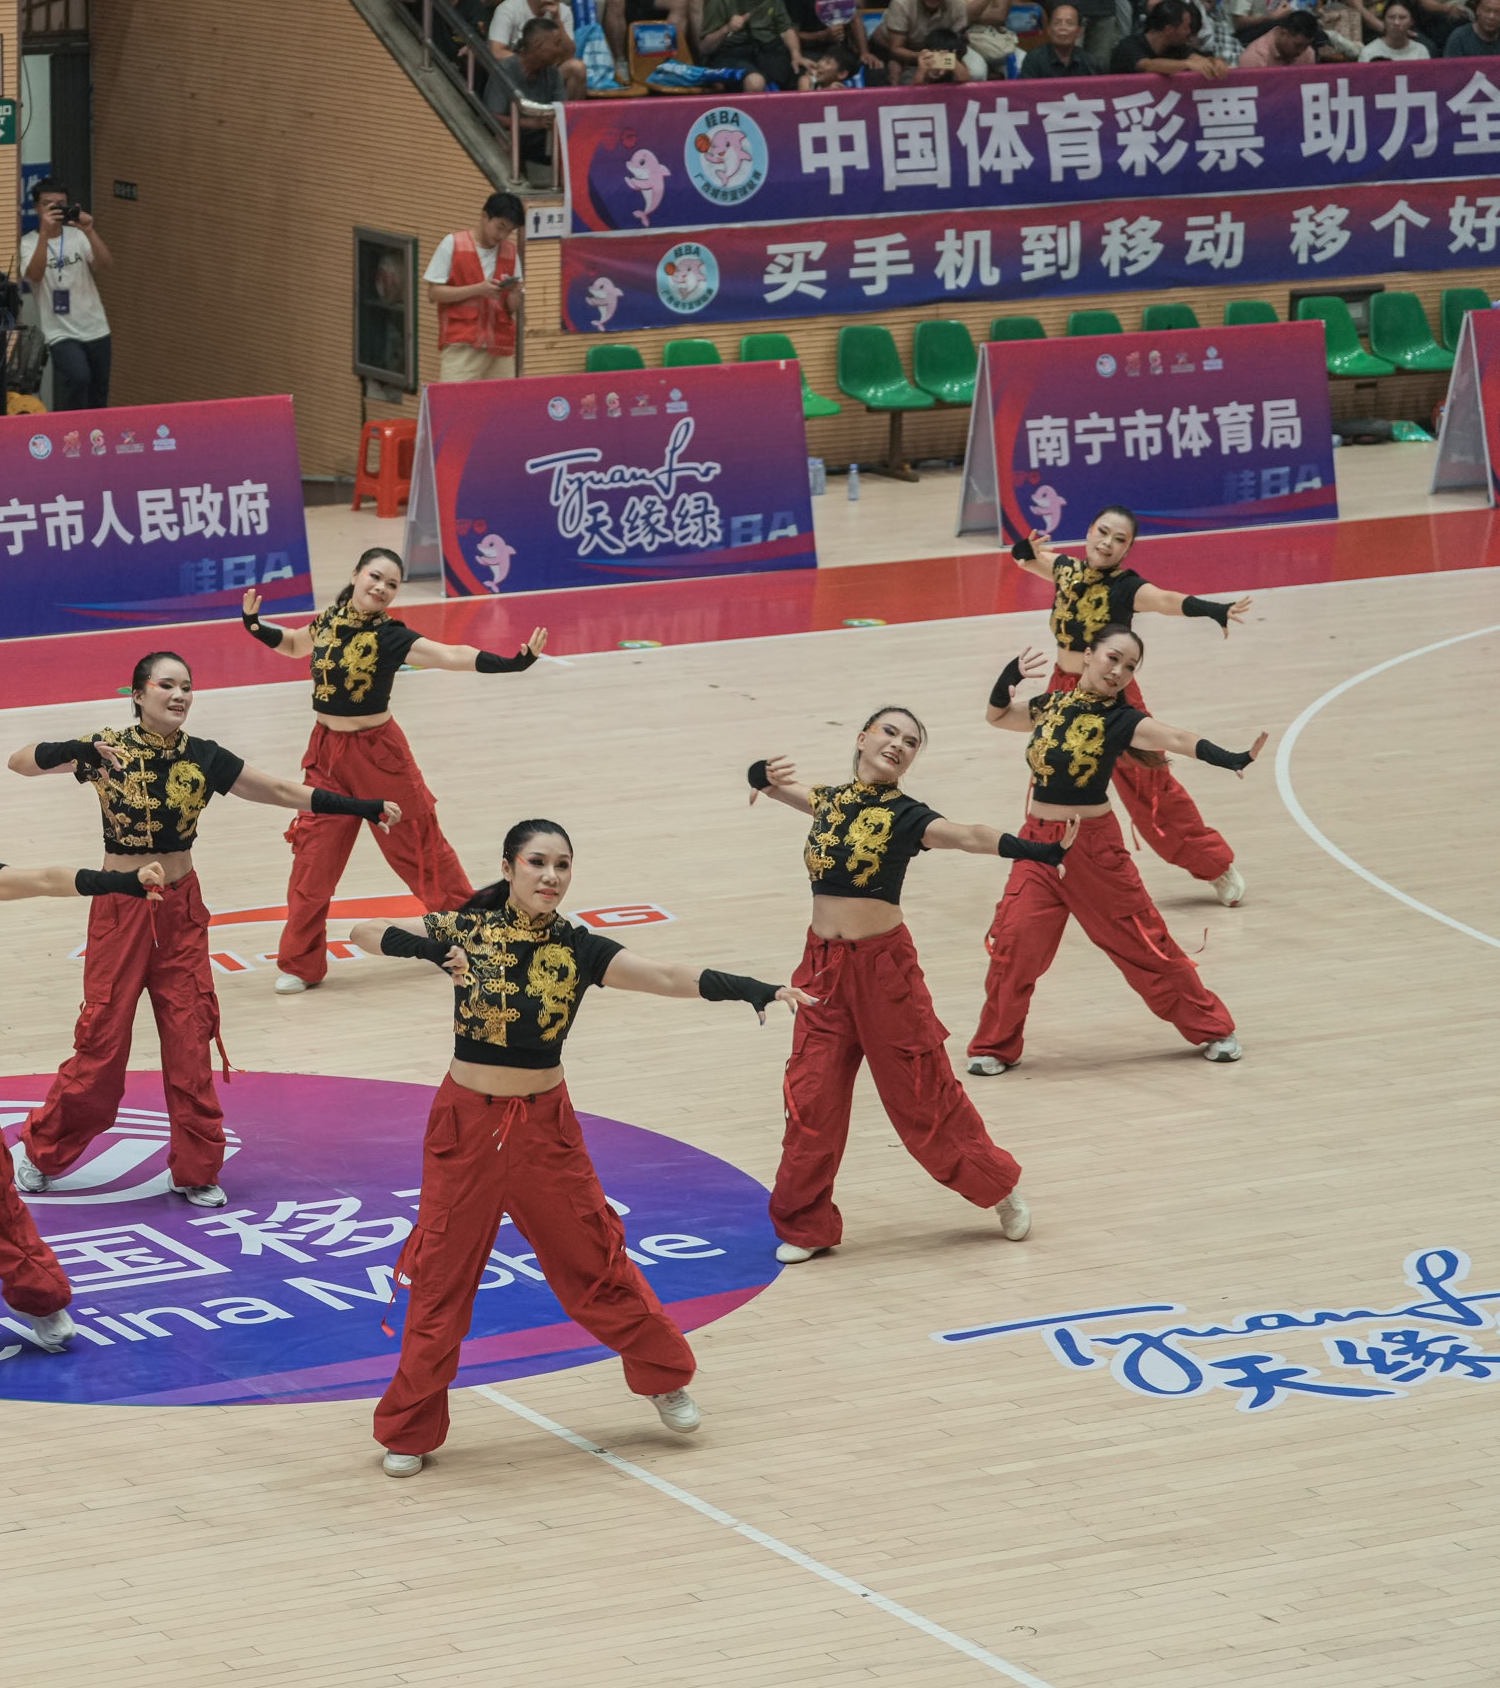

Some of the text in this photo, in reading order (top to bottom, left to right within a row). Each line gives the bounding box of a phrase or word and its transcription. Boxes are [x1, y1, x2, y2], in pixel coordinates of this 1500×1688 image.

[798, 85, 1266, 196] 中国体育彩票
[1301, 70, 1500, 165] 助力全
[762, 211, 1246, 303] 买手机到移动
[1290, 195, 1500, 264] 移个好
[1025, 398, 1302, 469] 南宁市体育局
[718, 511, 798, 550] BA
[180, 551, 294, 595] 桂BA
[1209, 1329, 1500, 1410] 天缘
